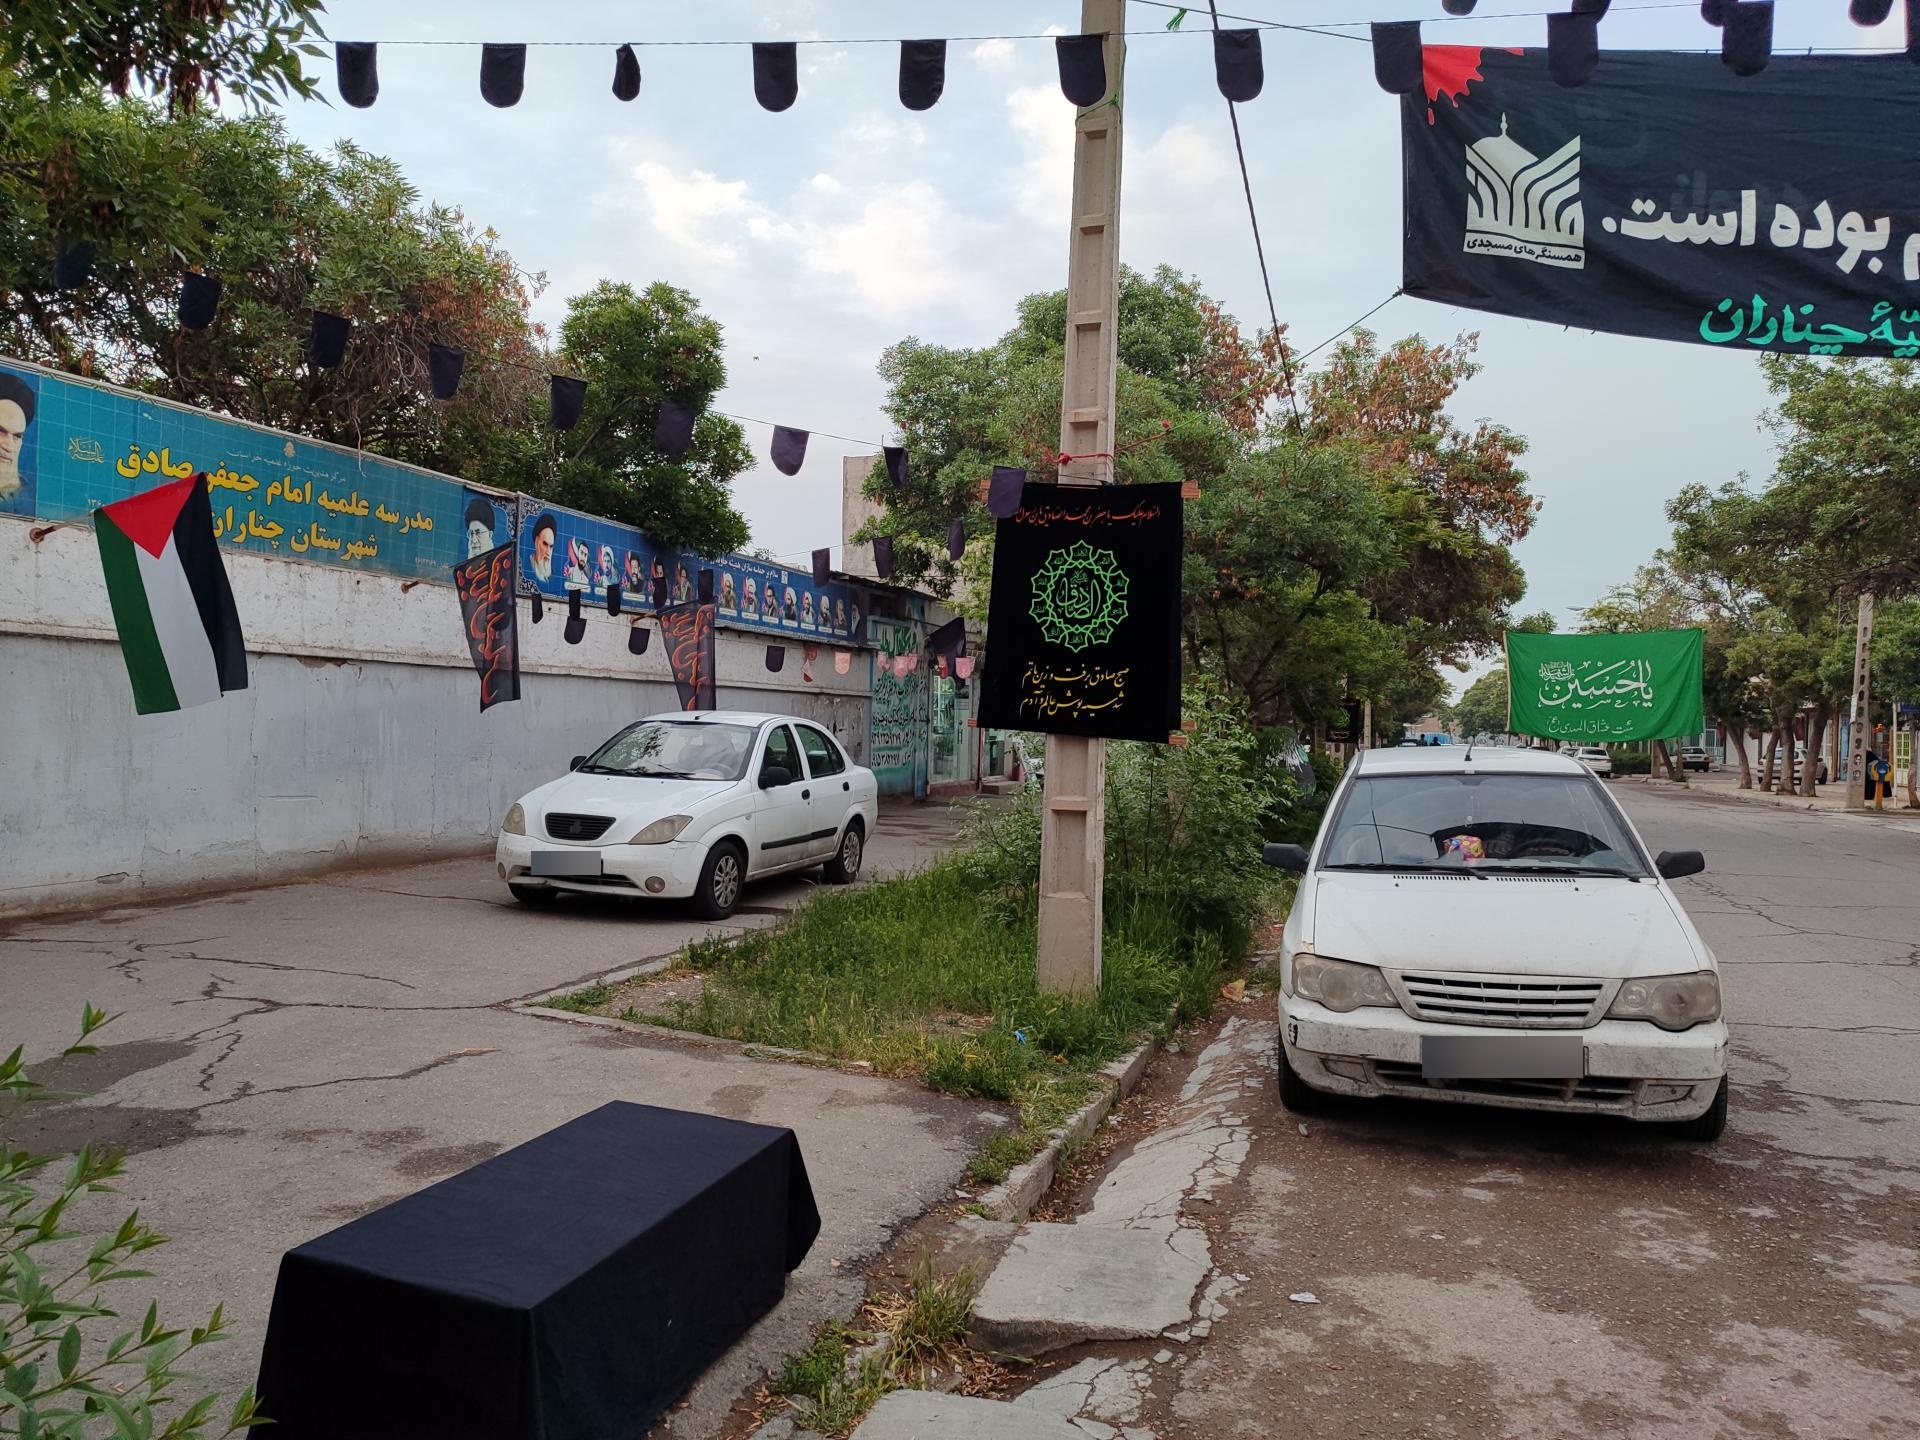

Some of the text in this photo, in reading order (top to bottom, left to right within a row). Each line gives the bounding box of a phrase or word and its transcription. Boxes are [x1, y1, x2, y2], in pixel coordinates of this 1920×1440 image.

[1602, 189, 1757, 247] است.
[1770, 200, 1890, 274] بوده
[1467, 238, 1513, 252] مسجدی
[1699, 294, 1868, 355] چناران
[116, 443, 433, 534] مدرسه علمیه امام جعفر صادق
[290, 521, 378, 561] شهرستان
[1056, 577, 1100, 618] الصادق
[1021, 661, 1037, 689] ماتم
[1054, 663, 1091, 689] برفت
[1089, 666, 1116, 686] صادق
[1113, 667, 1130, 688] صبح
[1539, 660, 1648, 709] حسین
[1047, 689, 1083, 718] پوش
